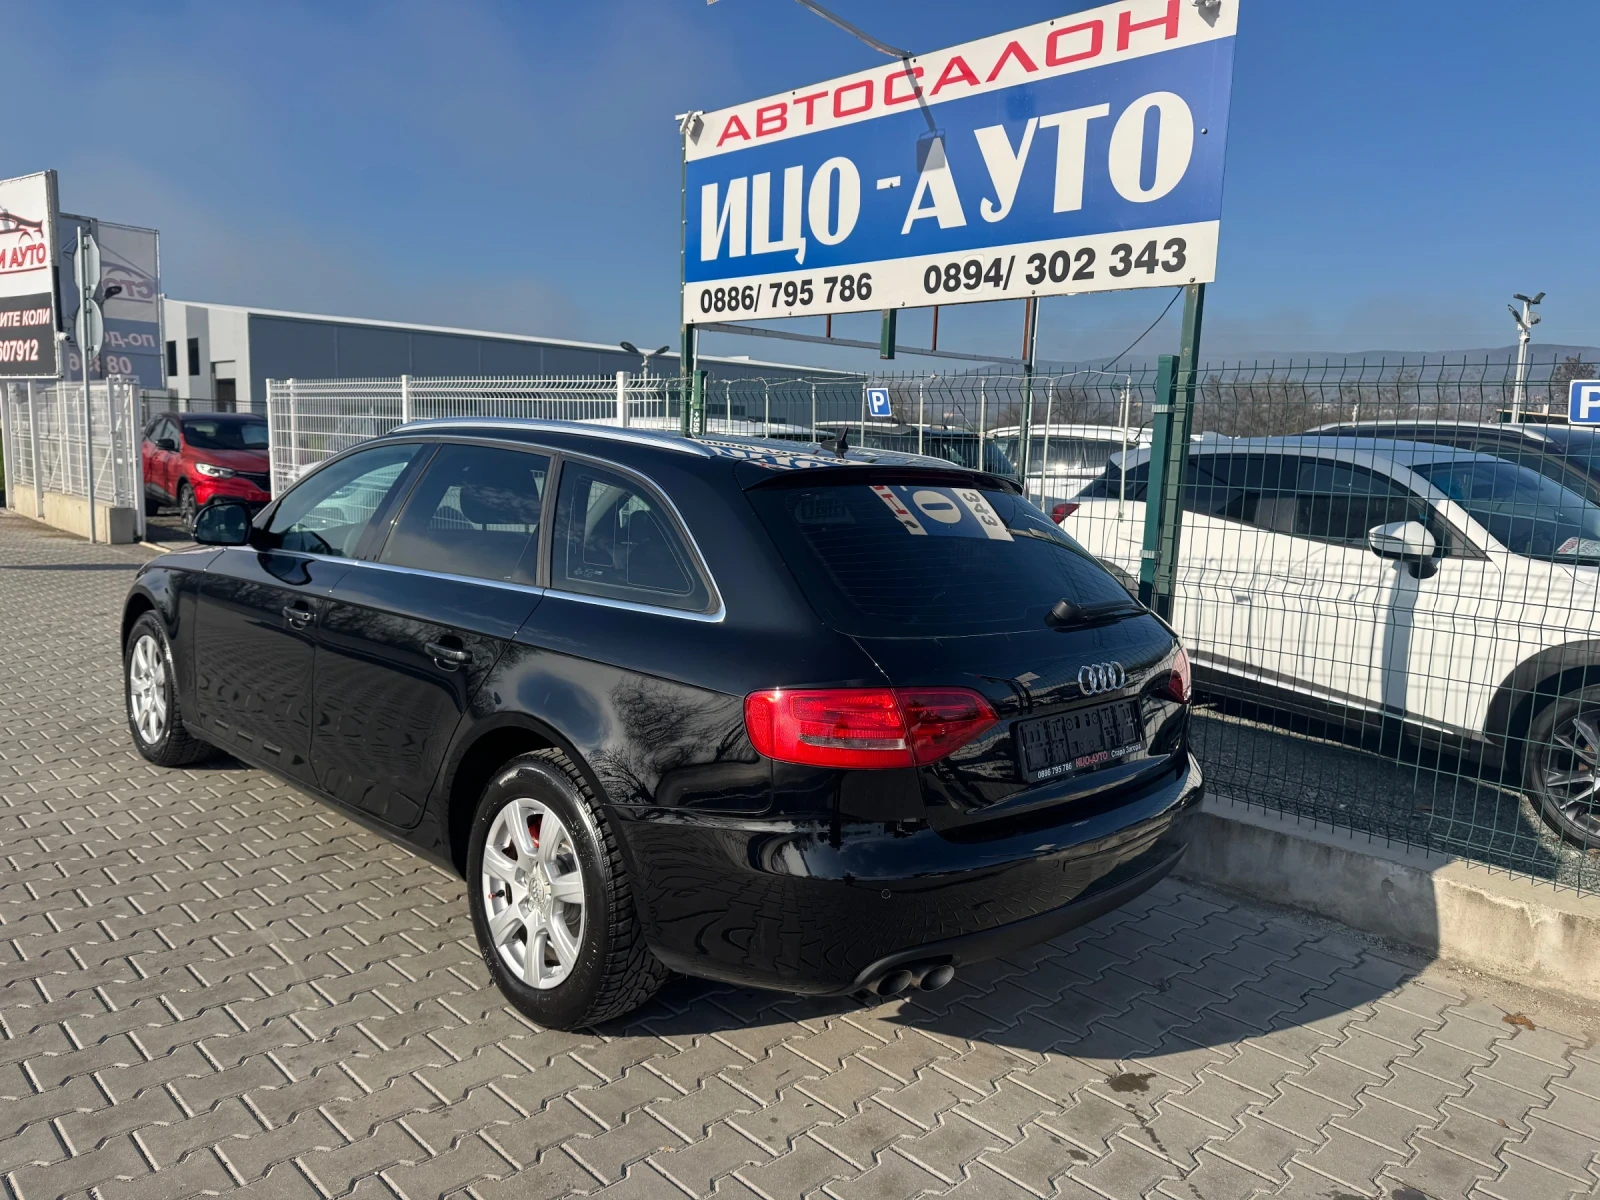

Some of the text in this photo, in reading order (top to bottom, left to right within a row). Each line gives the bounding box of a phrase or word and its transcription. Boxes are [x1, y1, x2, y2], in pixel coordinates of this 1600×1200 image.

[716, 0, 1180, 147] АВТОСАЛОН
[9, 242, 46, 268] АУТО
[923, 237, 1187, 294] 0894/ 302 343
[700, 272, 873, 314] 0886/ 795 786
[22, 307, 50, 326] КОЛИ
[871, 391, 885, 413] P
[1052, 765, 1062, 775] 795
[1075, 751, 1108, 768] ИЦО-АУТО
